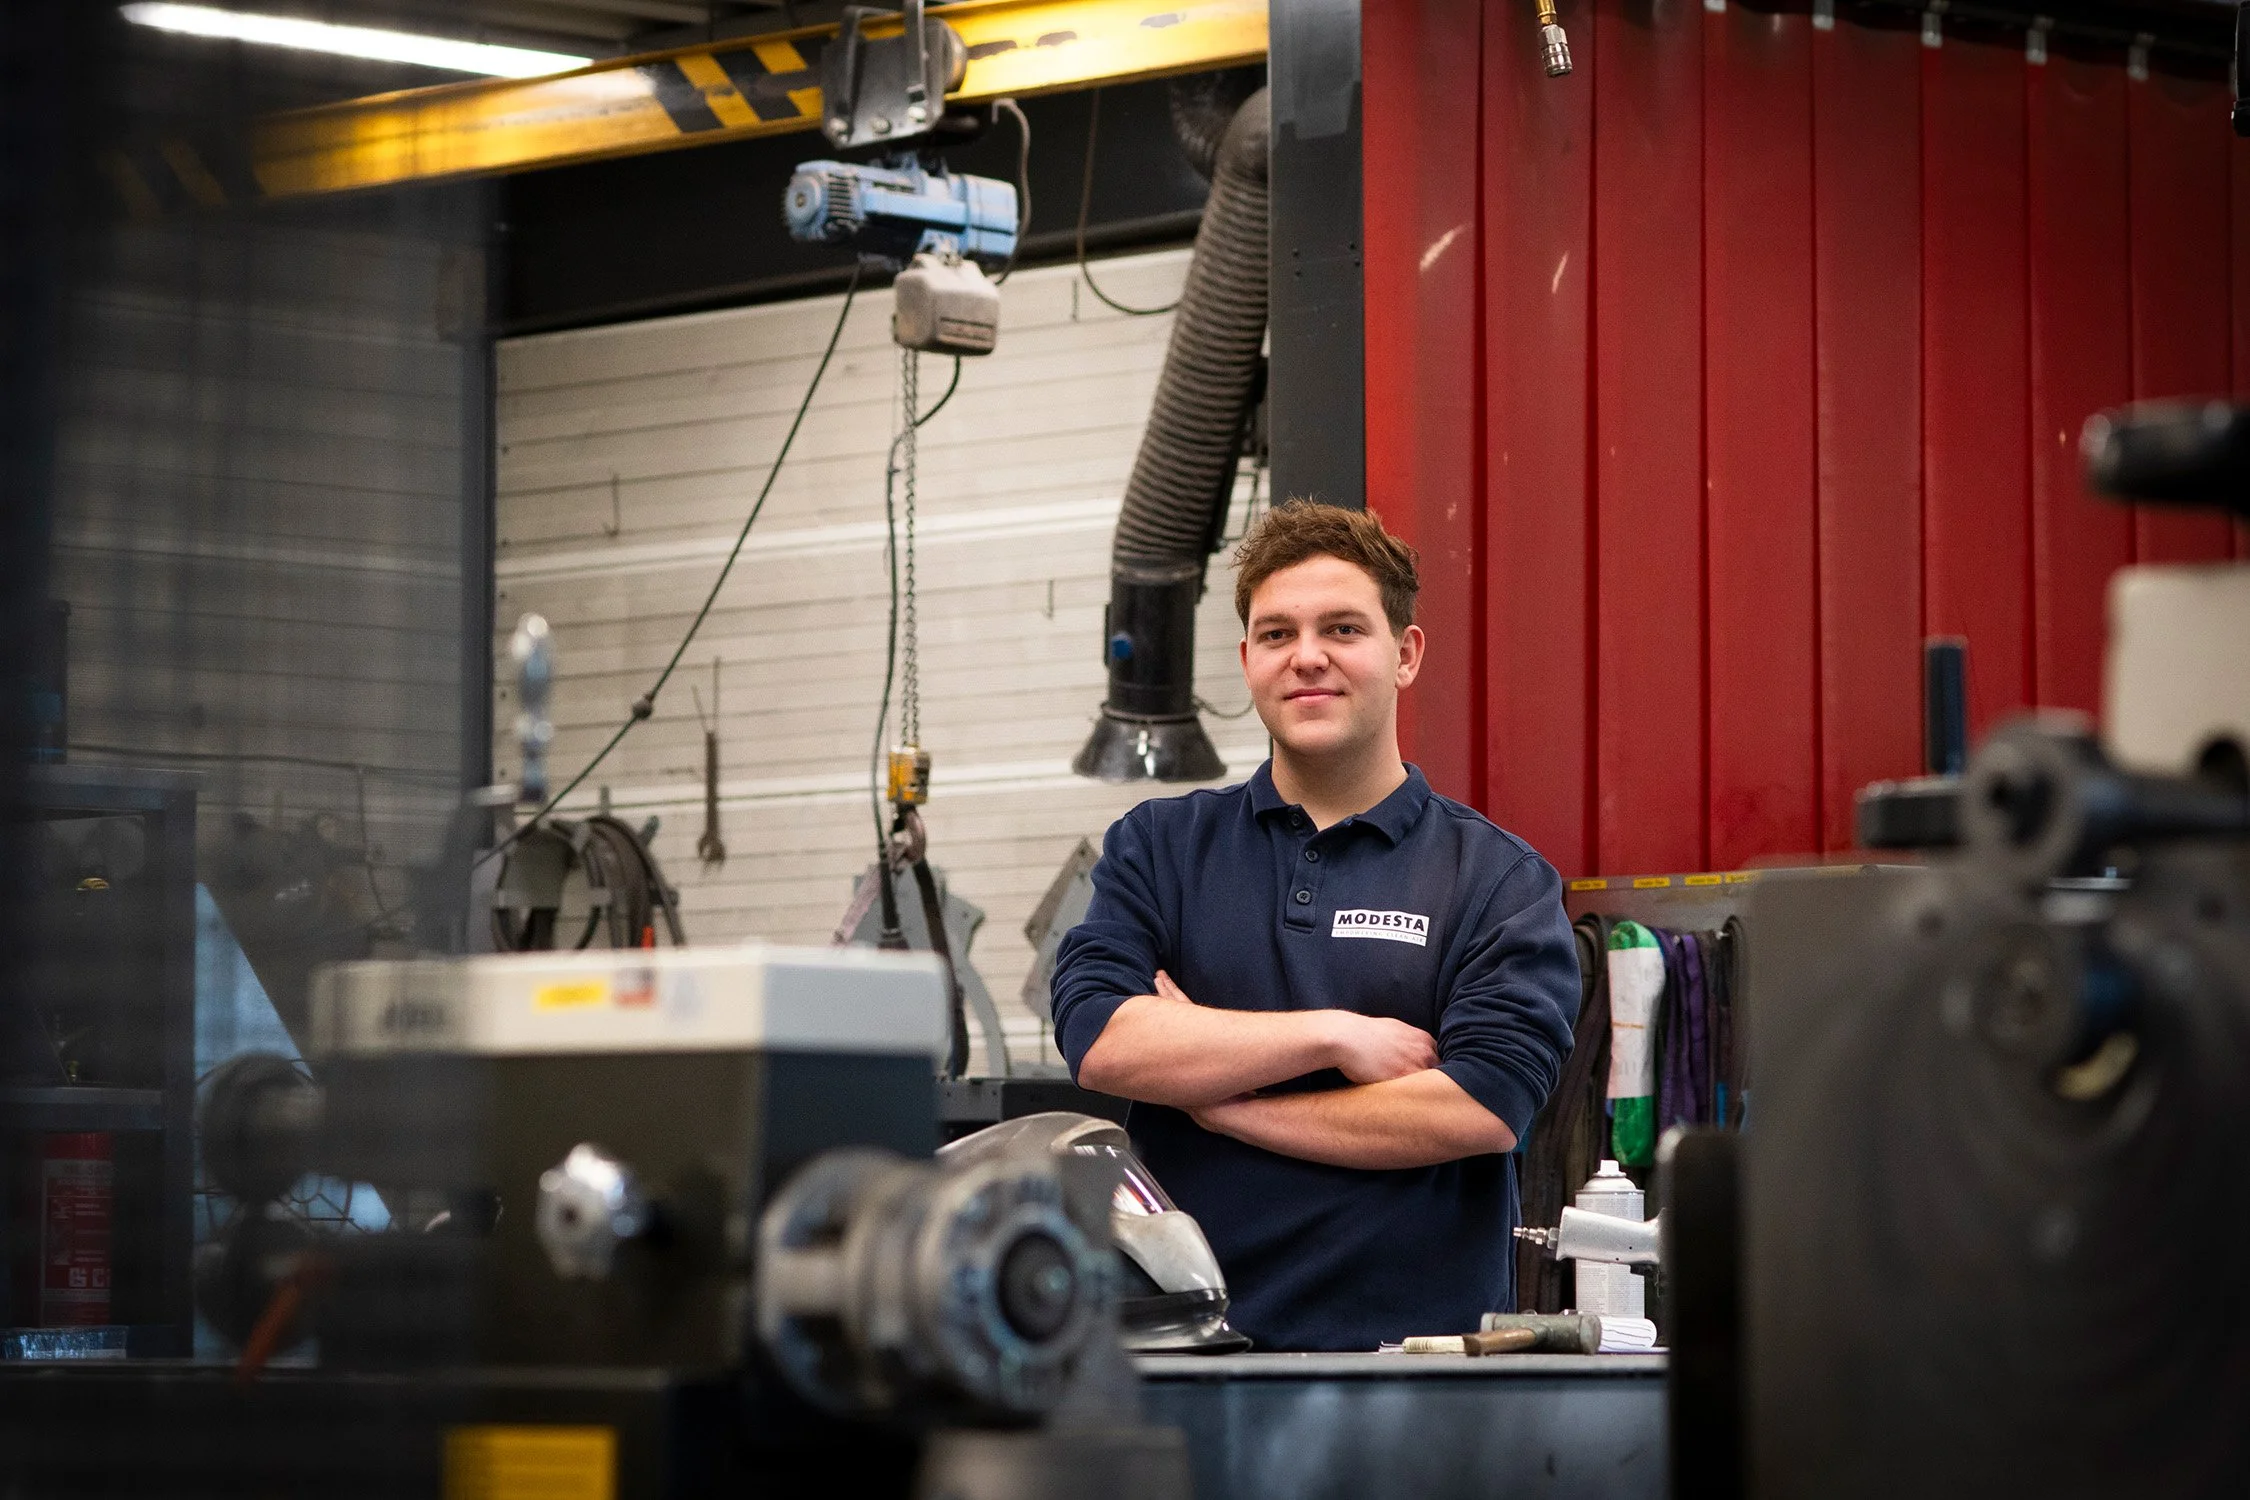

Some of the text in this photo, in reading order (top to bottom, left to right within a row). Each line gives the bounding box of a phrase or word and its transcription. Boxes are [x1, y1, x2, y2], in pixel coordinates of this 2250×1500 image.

[1338, 913, 1425, 931] MODESTA
[1386, 932, 1409, 940] CLEAN
[1411, 935, 1424, 943] AIR
